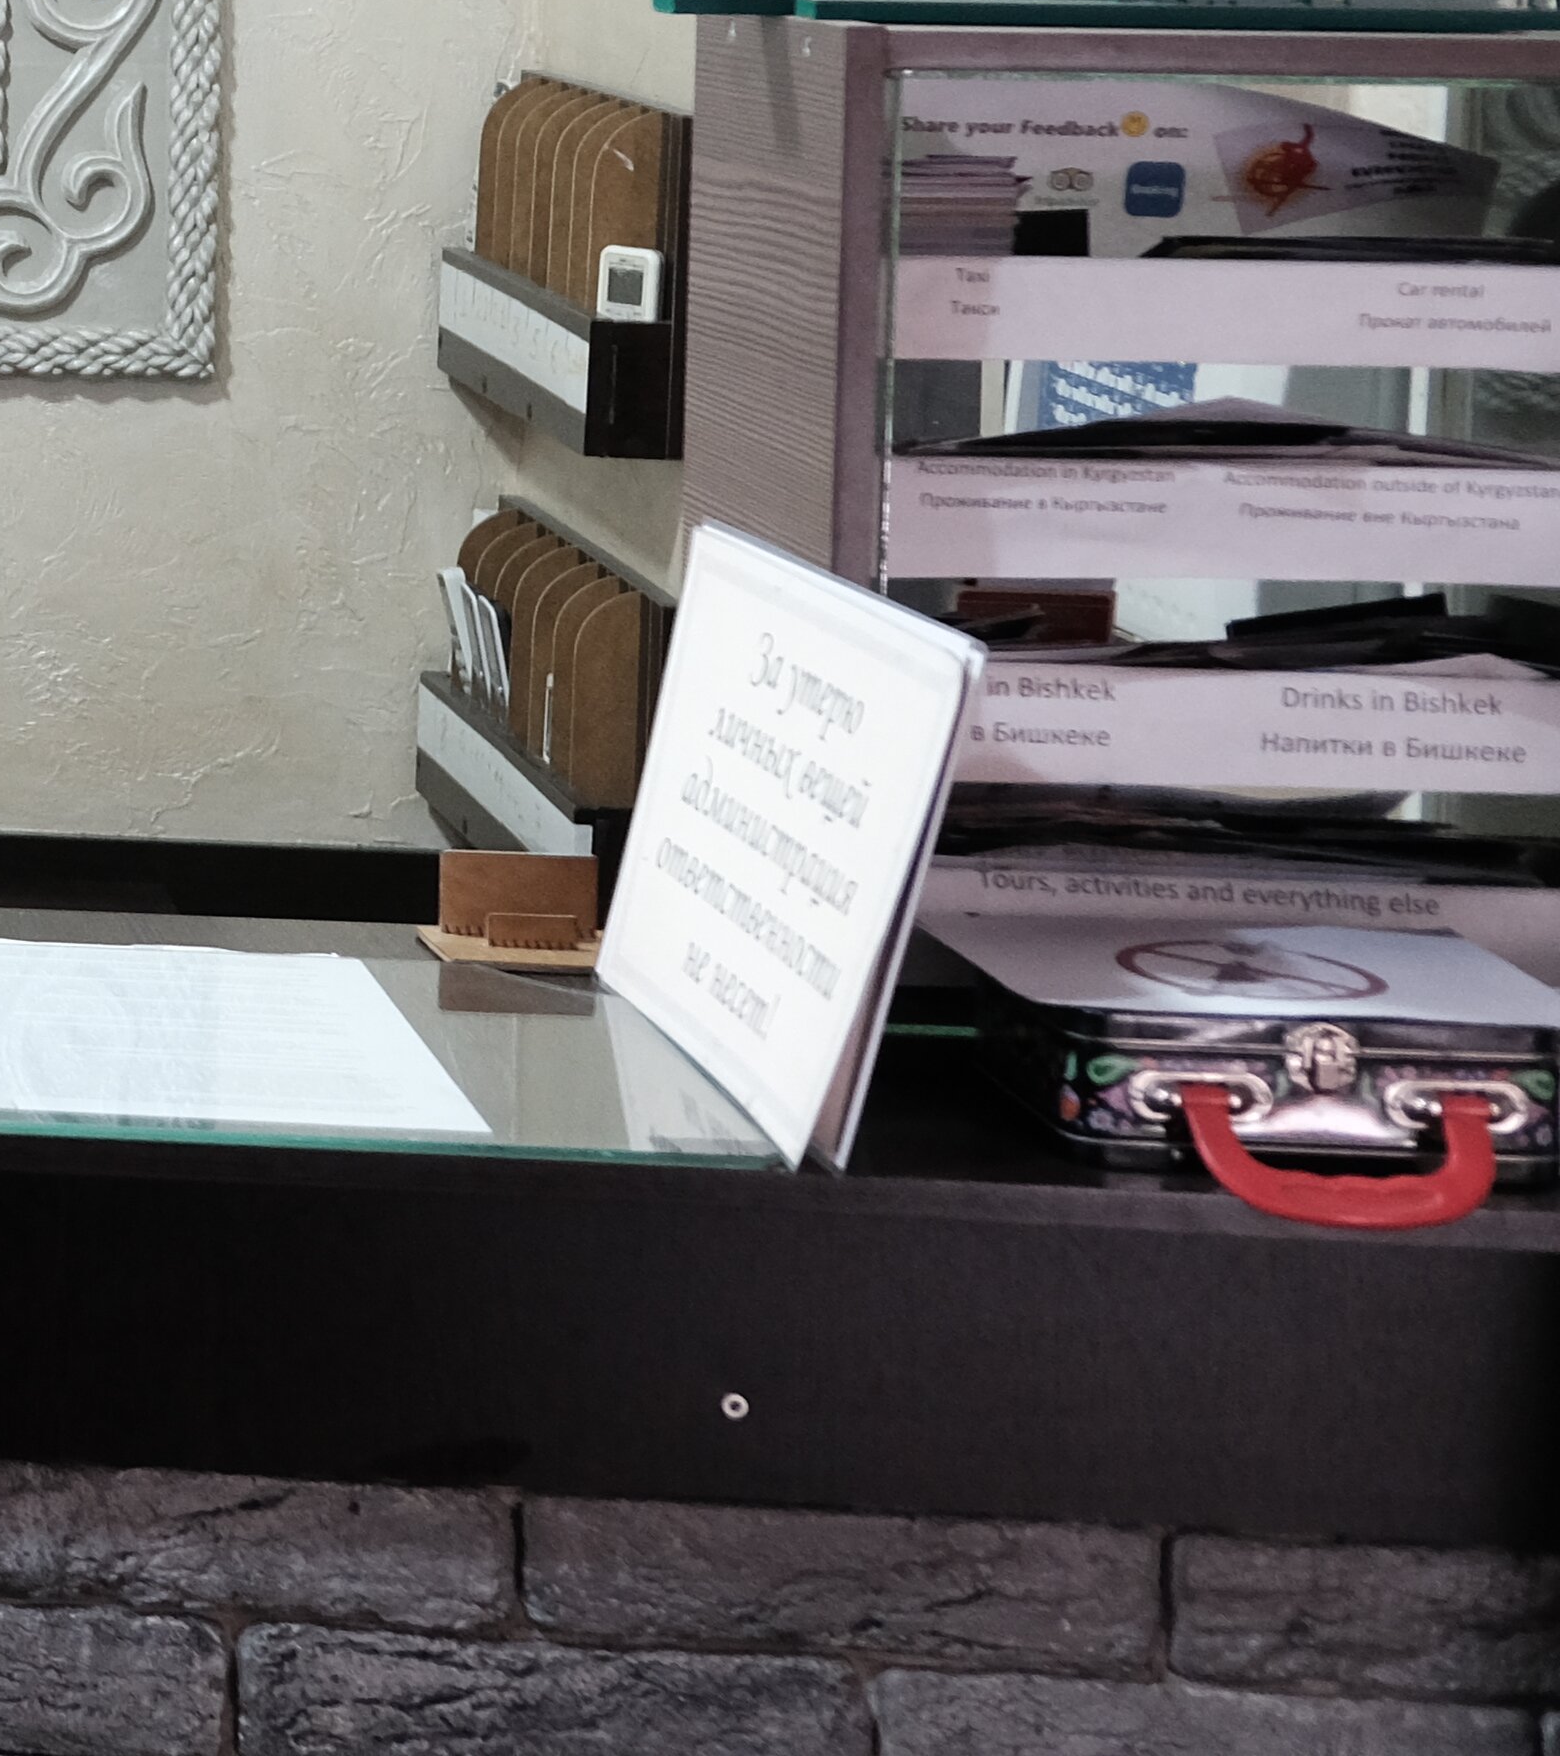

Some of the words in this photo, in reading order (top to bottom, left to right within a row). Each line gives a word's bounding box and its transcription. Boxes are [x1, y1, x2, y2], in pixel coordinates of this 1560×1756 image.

[901, 116, 960, 134] Share
[966, 120, 1013, 137] your
[1020, 119, 1119, 137] Feedback
[1154, 126, 1188, 138] on:
[956, 267, 990, 283] Taxi
[1397, 282, 1425, 296] Car
[1432, 284, 1485, 298] rental
[950, 300, 1001, 316] Такси
[1359, 313, 1421, 330] Прокат
[1427, 316, 1552, 333] автомобилей
[917, 460, 1058, 478] Accommodation
[1063, 464, 1078, 479] in
[1083, 466, 1175, 484] Kyrgyzstan
[1223, 470, 1366, 490] Accommodation
[1372, 478, 1437, 494] outside
[1444, 480, 1461, 494] of
[918, 493, 1033, 511] Проживание
[1038, 499, 1047, 510] в
[1052, 498, 1167, 515] Кыргызстане
[1238, 502, 1357, 524] Проживание
[1362, 511, 1394, 524] вне
[1400, 511, 1520, 531] Кыргызстана
[749, 632, 784, 689] За
[776, 664, 866, 741] утерю
[986, 678, 1011, 697] in
[1017, 679, 1116, 703] Bishkek
[1281, 686, 1364, 712] Drinks
[1370, 692, 1396, 712] in
[1403, 692, 1504, 717] Bishkek
[970, 724, 985, 742] в
[992, 724, 1112, 747] Бишкеке
[1260, 731, 1373, 757] Напитки
[1382, 742, 1397, 757] в
[1405, 738, 1528, 764] Бишкеке
[708, 708, 802, 800] личных
[798, 759, 872, 830] вещей
[680, 754, 860, 917] администрация
[978, 869, 1058, 897] Tours,
[1064, 874, 1180, 901] activities
[1187, 880, 1235, 904] and
[1242, 886, 1380, 918] everything
[1389, 892, 1439, 917] else
[655, 837, 843, 1001] ответственности
[682, 941, 711, 984] не
[715, 960, 783, 1042] несет!
